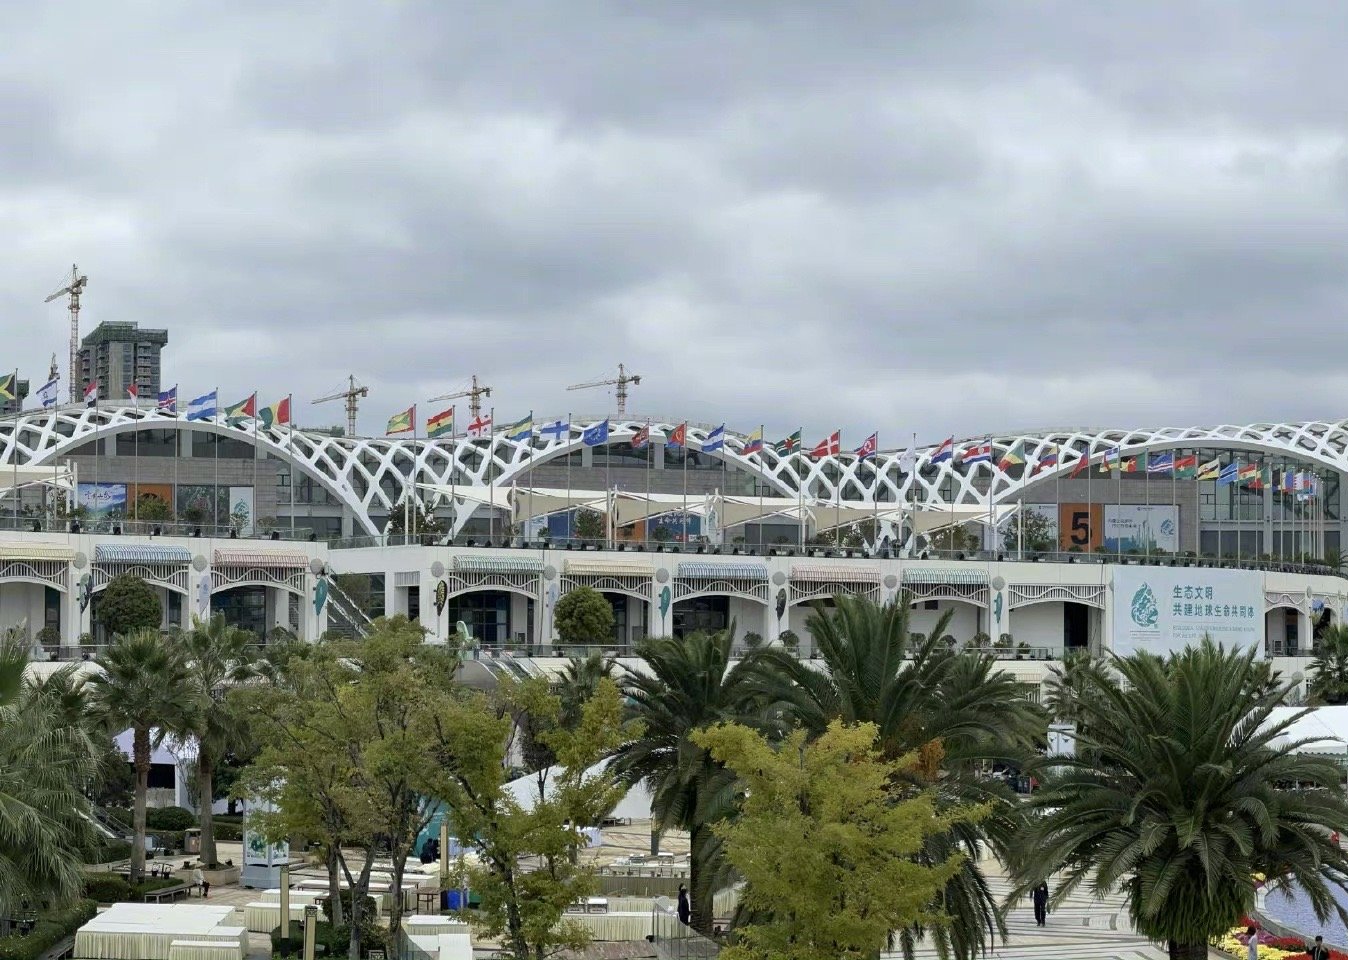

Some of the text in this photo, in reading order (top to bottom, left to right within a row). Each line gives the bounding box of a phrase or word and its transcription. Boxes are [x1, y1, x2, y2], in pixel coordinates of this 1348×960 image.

[1071, 512, 1092, 545] 5
[1173, 584, 1214, 600] 生态文明
[1172, 602, 1255, 619] 共建地球生命共同体
